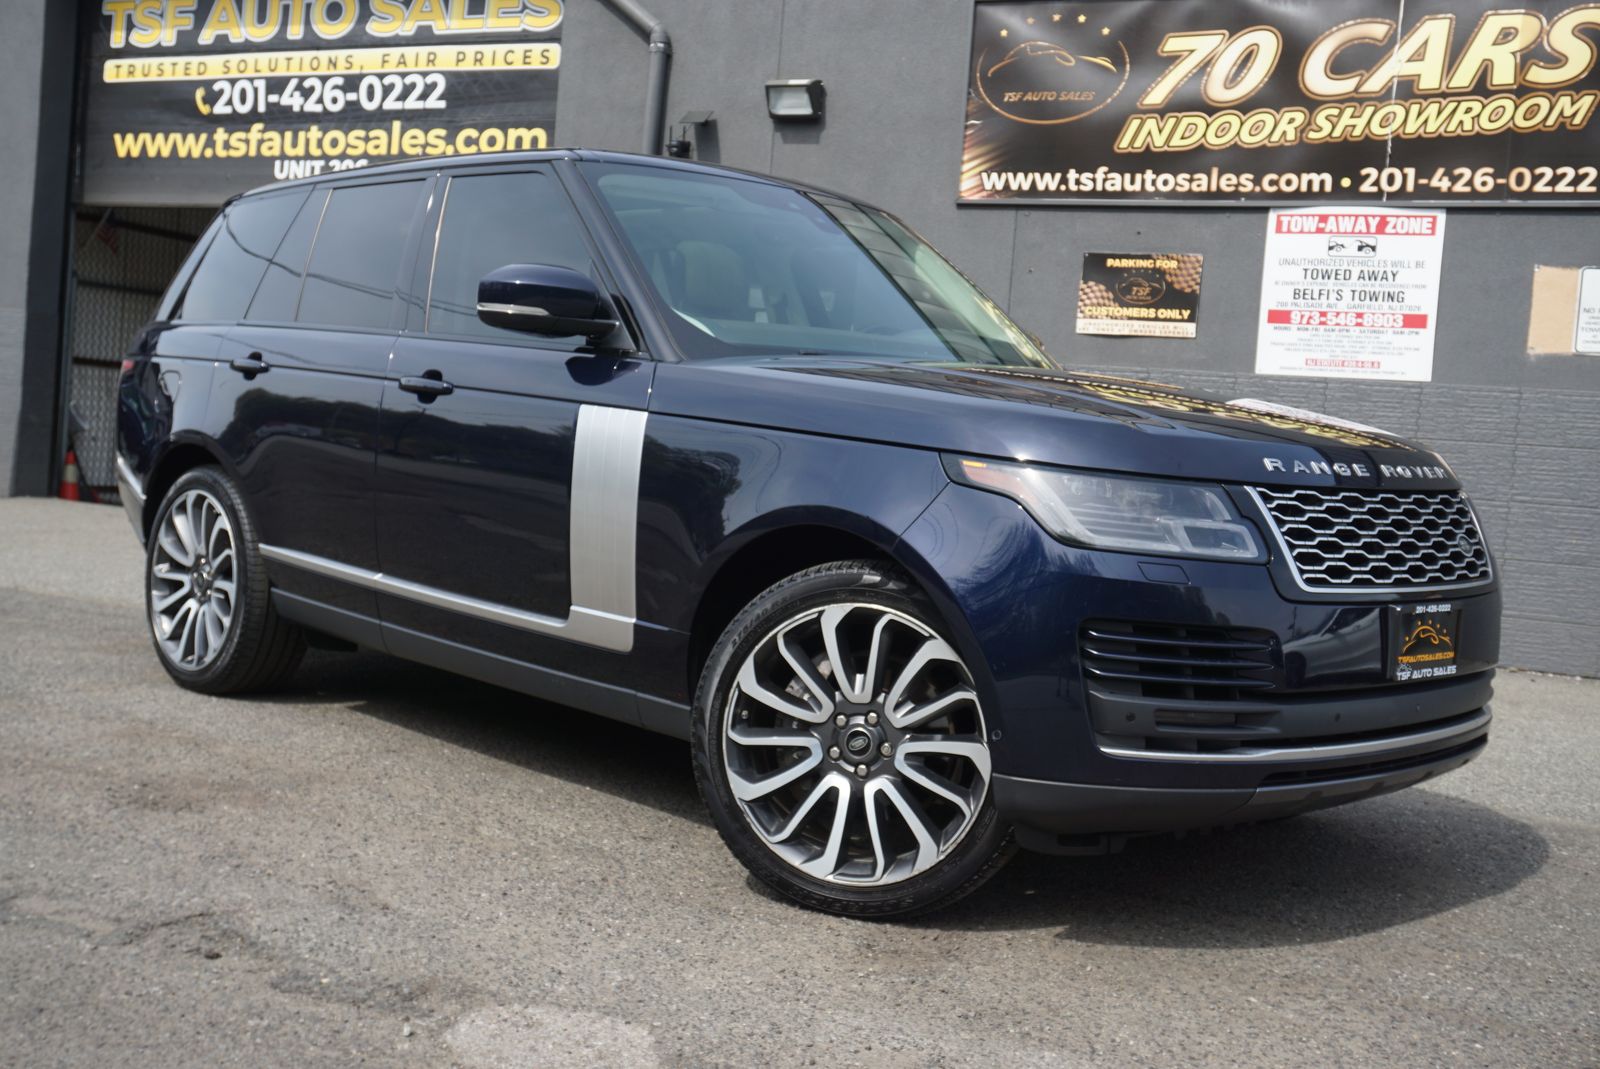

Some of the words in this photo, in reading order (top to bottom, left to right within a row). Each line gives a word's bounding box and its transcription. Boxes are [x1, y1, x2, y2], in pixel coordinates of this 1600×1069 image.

[103, 0, 194, 48] TSF
[198, 0, 358, 44] AUTO
[366, 0, 564, 36] SALES
[114, 61, 208, 78] TRUSTED
[222, 55, 364, 74] SOLUTIONS,
[381, 52, 437, 68] FAIR
[456, 49, 551, 66] PRICES
[1137, 25, 1283, 110] 70
[1298, 3, 1600, 99] CARS
[213, 73, 447, 115] 201-426-0222
[1003, 92, 1022, 102] TSF
[1024, 91, 1057, 101] AUTO
[1058, 91, 1096, 102] SALES
[1114, 107, 1309, 154] INDOOR
[1304, 89, 1600, 143] SHOWROOM
[113, 121, 547, 159] www.tsfautosales.com
[273, 159, 325, 180] UNIT
[981, 166, 1333, 193] www.tsfautosales.com
[1358, 166, 1598, 194] 201-426-0222
[1280, 215, 1381, 234] TOW-AWAY
[1384, 217, 1433, 234] ZONE
[1106, 258, 1154, 268] PARKING
[1156, 260, 1178, 268] FOR
[1278, 258, 1345, 267] UNAUTHORIZED
[1347, 259, 1389, 268] VEHICLES
[1391, 260, 1412, 269] WILL
[1415, 260, 1426, 269] BE
[1303, 268, 1352, 281] TOWED
[1357, 270, 1399, 282] AWAY
[1292, 288, 1343, 301] BELFI'S
[1350, 289, 1405, 303] TOWING
[1085, 306, 1156, 318] CUSTOMERS
[1157, 308, 1191, 319] ONLY
[1263, 457, 1370, 477] RANGE
[1380, 464, 1448, 479] ROVER
[1396, 671, 1411, 681] TSF
[1412, 668, 1432, 679] AUTO
[1433, 665, 1457, 677] SALES
